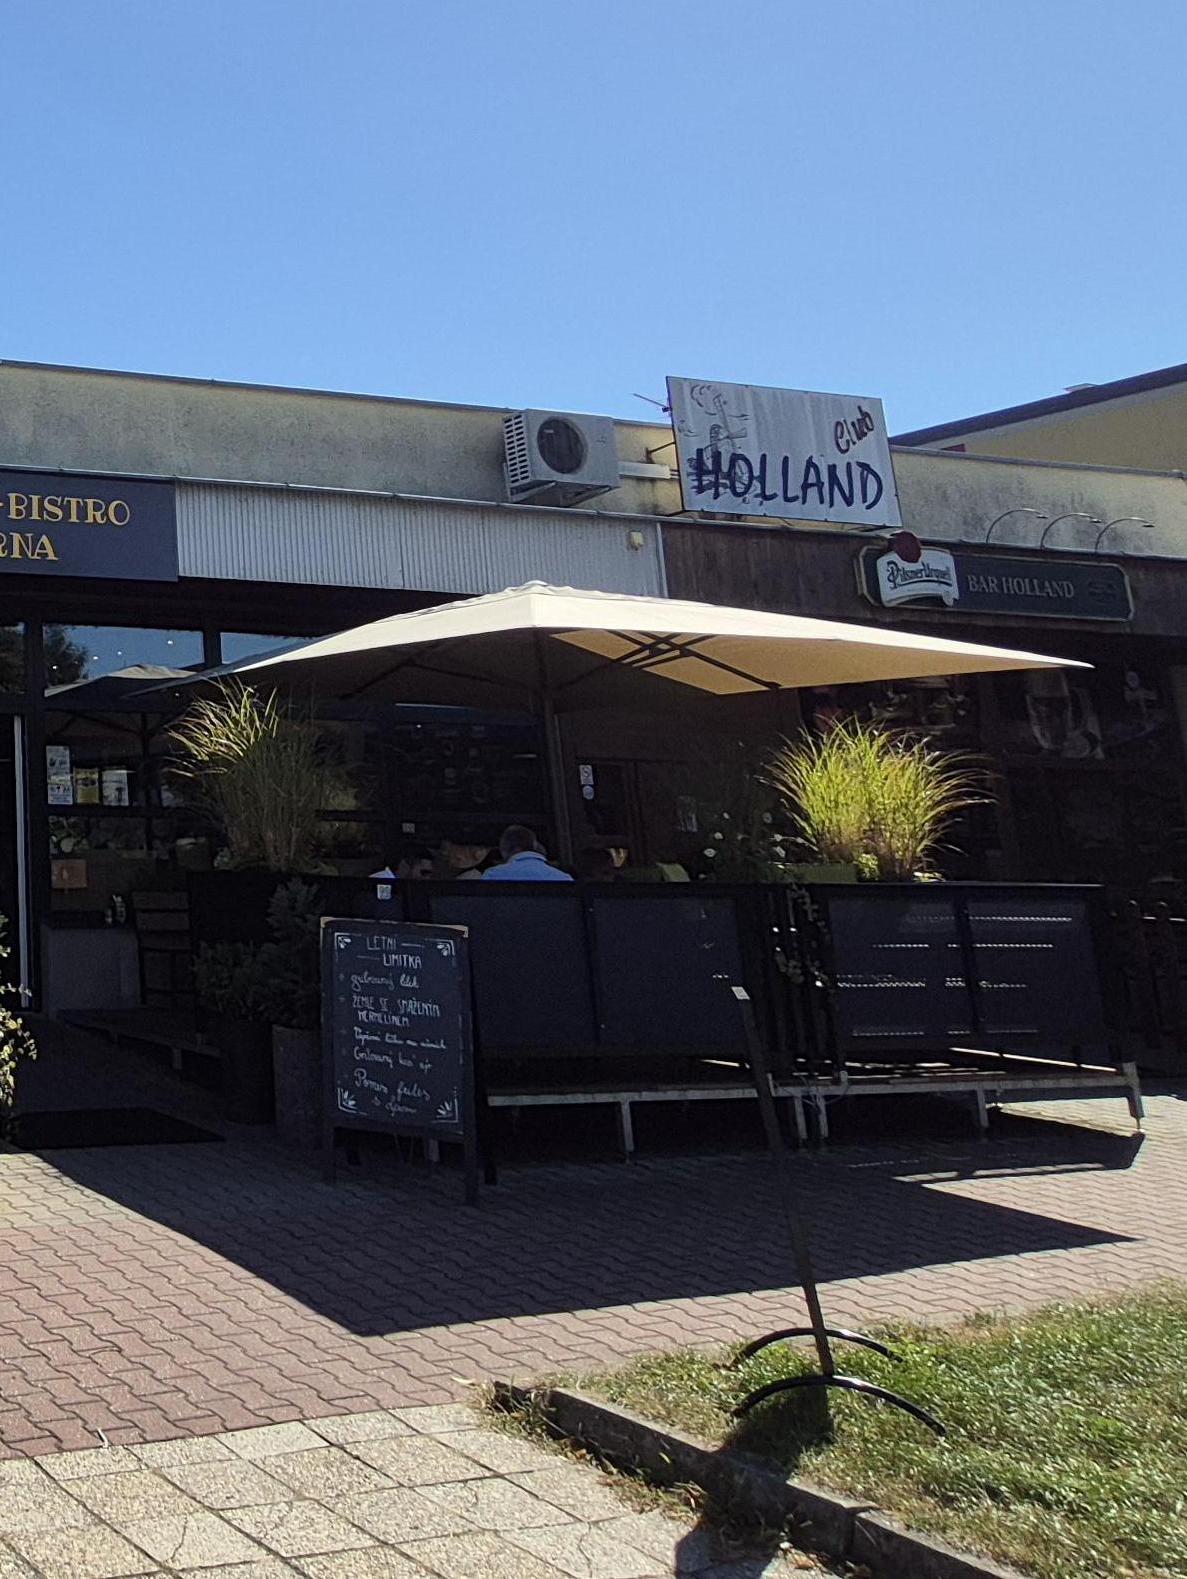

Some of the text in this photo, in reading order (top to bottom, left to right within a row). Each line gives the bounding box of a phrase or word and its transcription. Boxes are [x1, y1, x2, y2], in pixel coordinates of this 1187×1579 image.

[833, 405, 875, 455] Club
[695, 448, 884, 510] HOLLAND
[887, 561, 922, 590] Pilsner
[967, 574, 1075, 599] BAR HOLLAND
[382, 953, 422, 969] LIMITKA
[379, 997, 389, 1012] SE
[397, 997, 440, 1017] SMAŽENÝM
